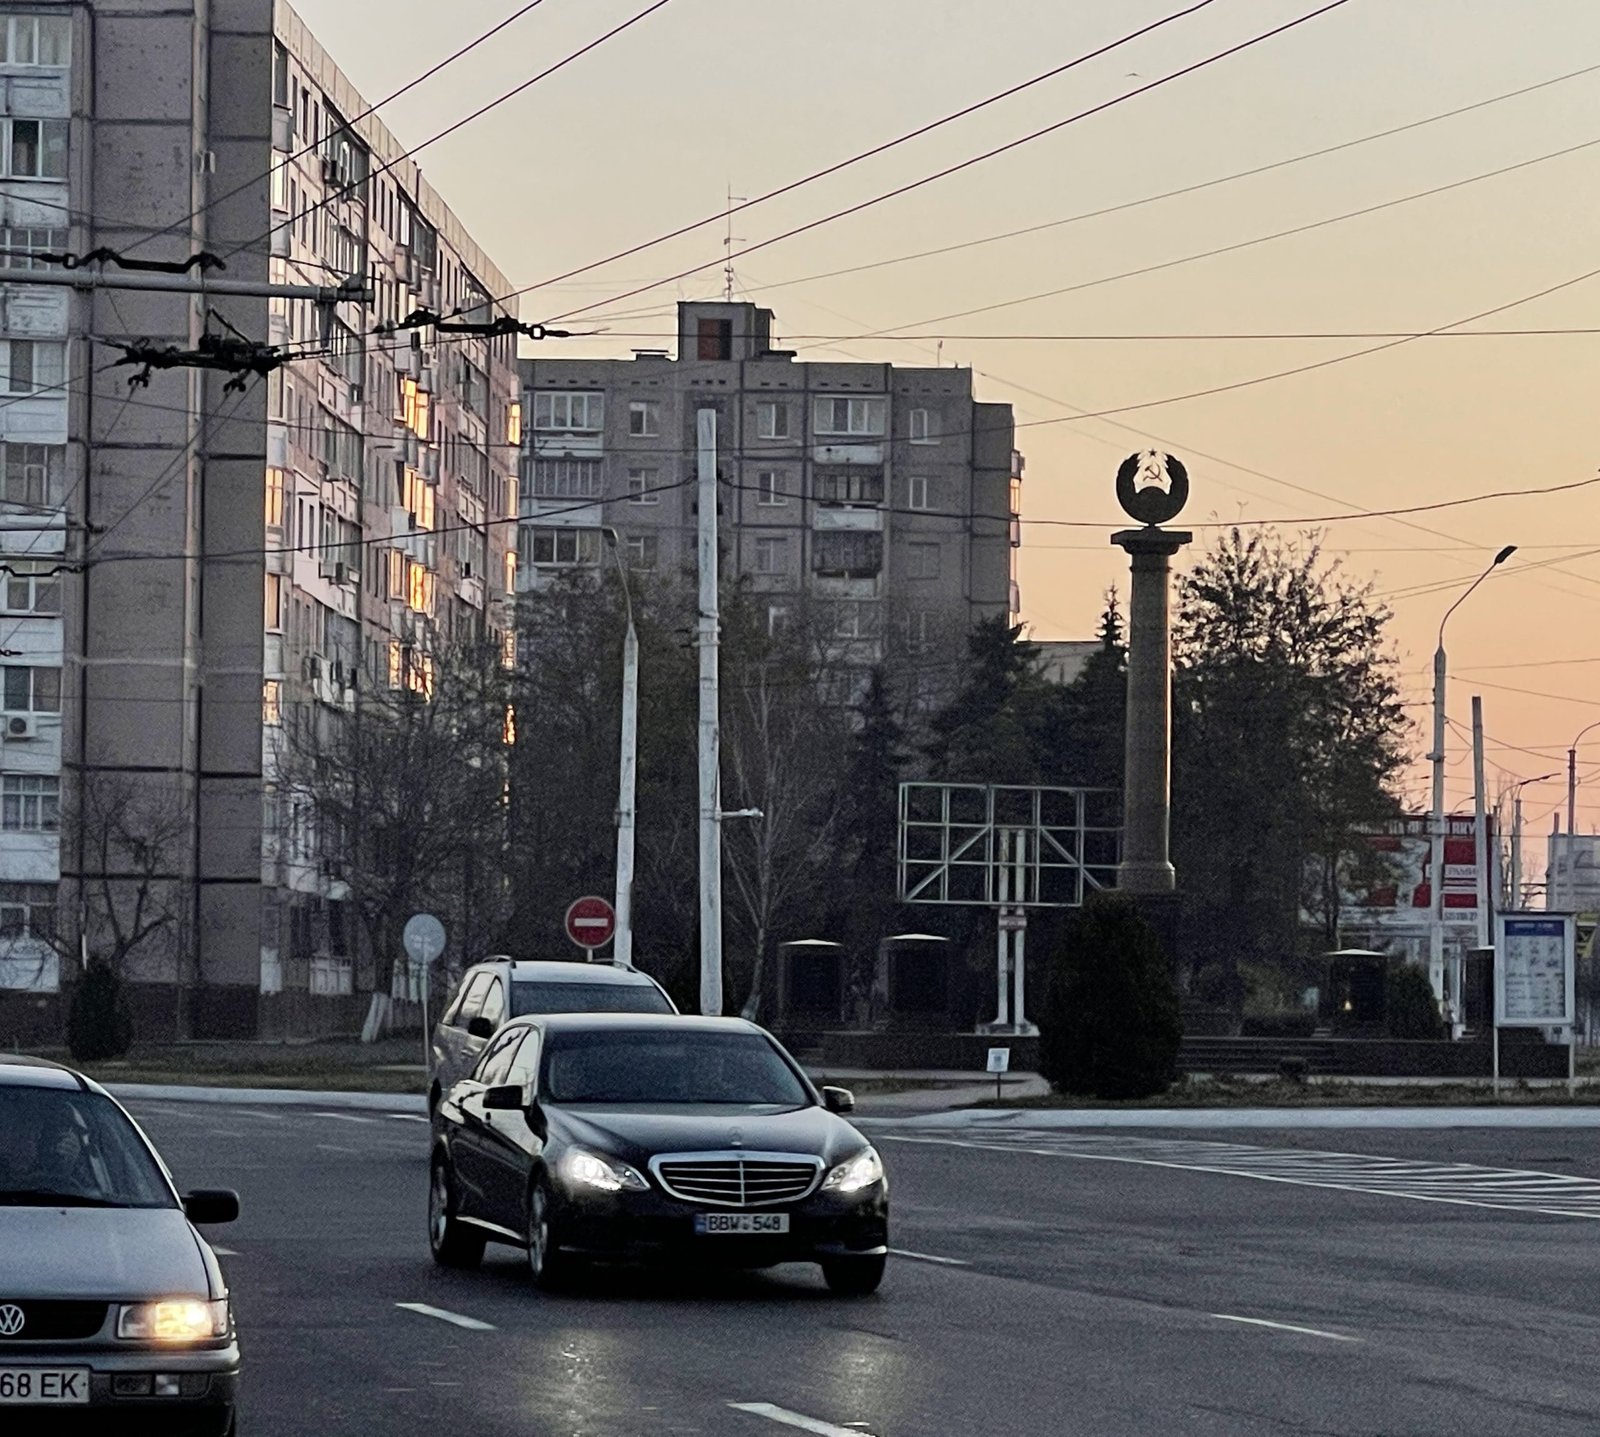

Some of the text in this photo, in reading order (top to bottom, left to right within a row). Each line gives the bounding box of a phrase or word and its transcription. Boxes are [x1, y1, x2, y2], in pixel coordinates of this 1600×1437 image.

[709, 1215, 781, 1231] BBW 548
[0, 1373, 79, 1397] 68 EK
